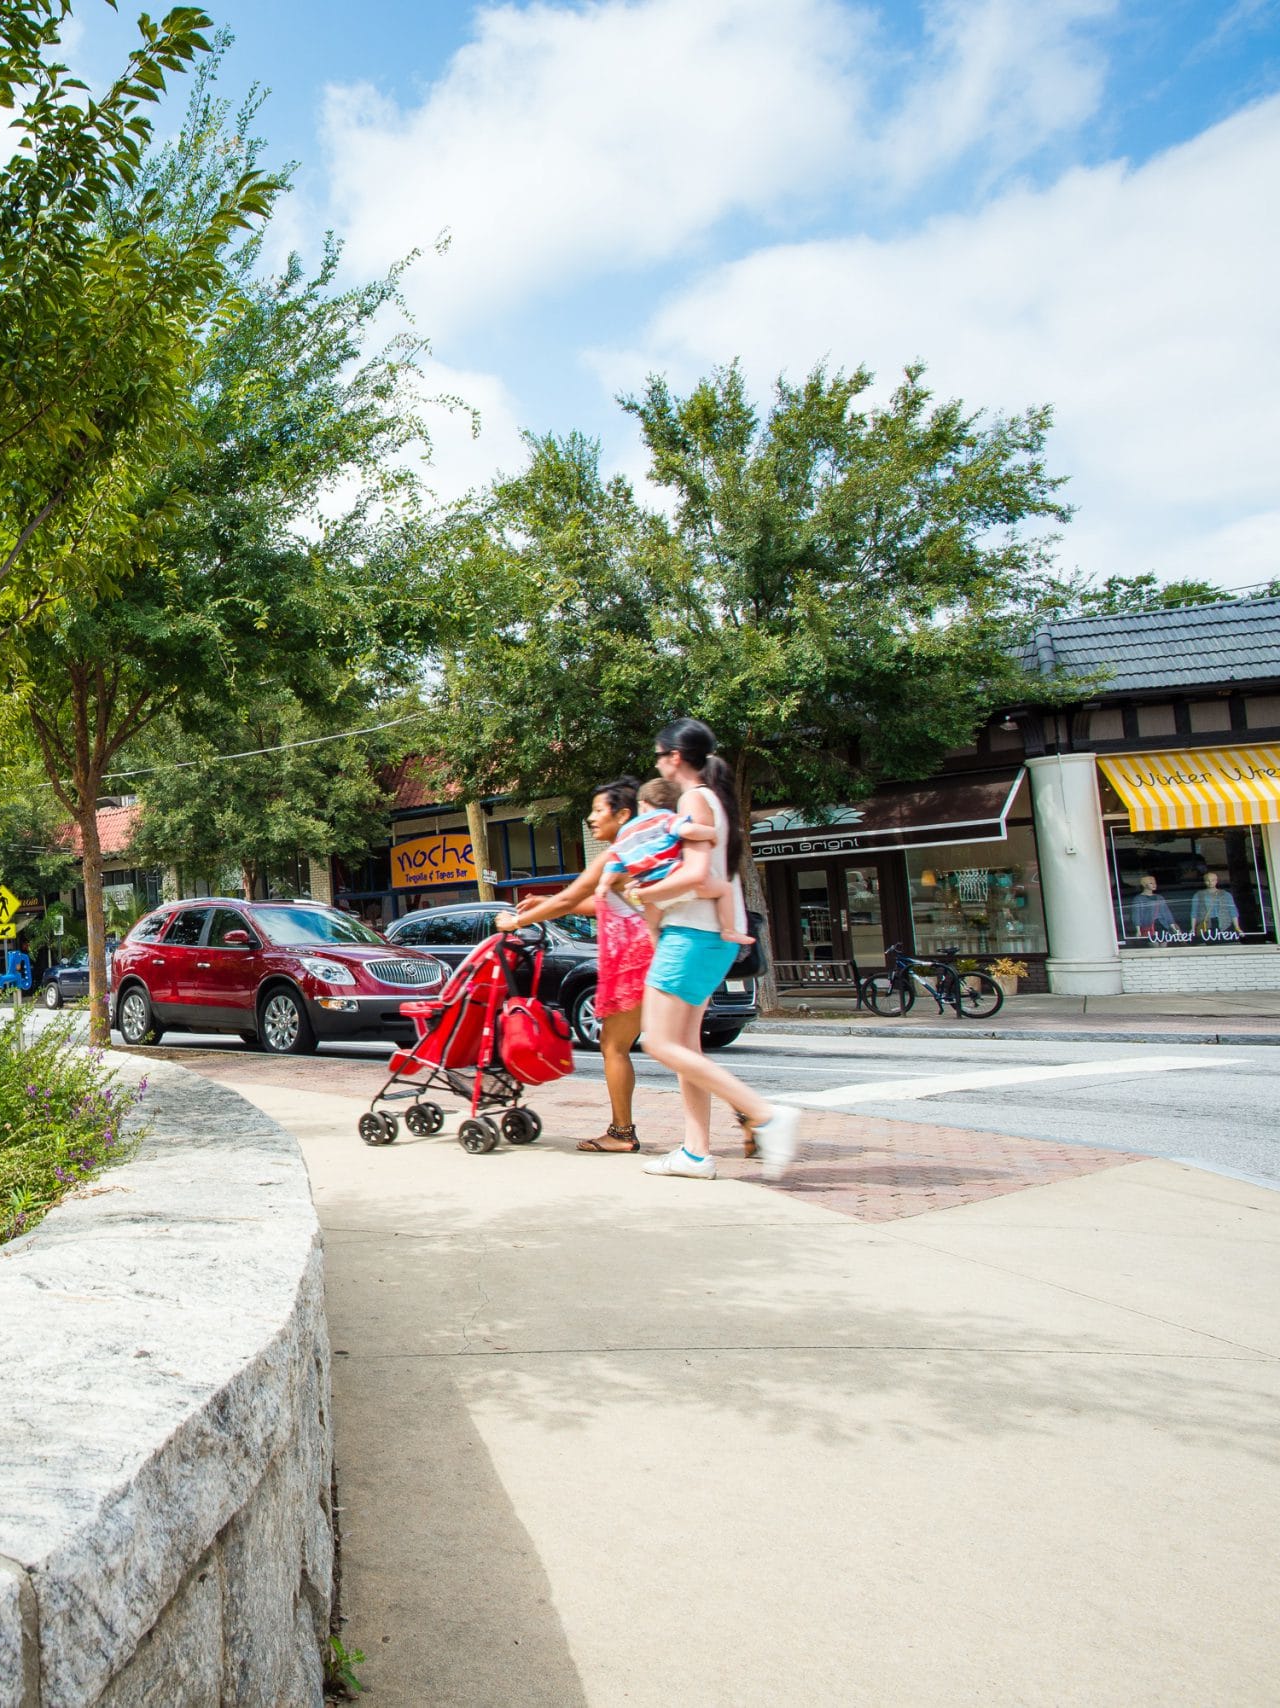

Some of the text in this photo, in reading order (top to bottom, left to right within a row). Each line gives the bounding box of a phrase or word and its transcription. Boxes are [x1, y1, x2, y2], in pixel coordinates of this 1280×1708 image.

[1122, 765, 1280, 788] Winter Wre
[396, 836, 475, 872] noche
[752, 837, 859, 856] udith Bright
[405, 873, 428, 884] Tequila
[436, 870, 455, 881] Tapas
[456, 868, 468, 878] Bar
[1147, 928, 1240, 943] Winter Wren
